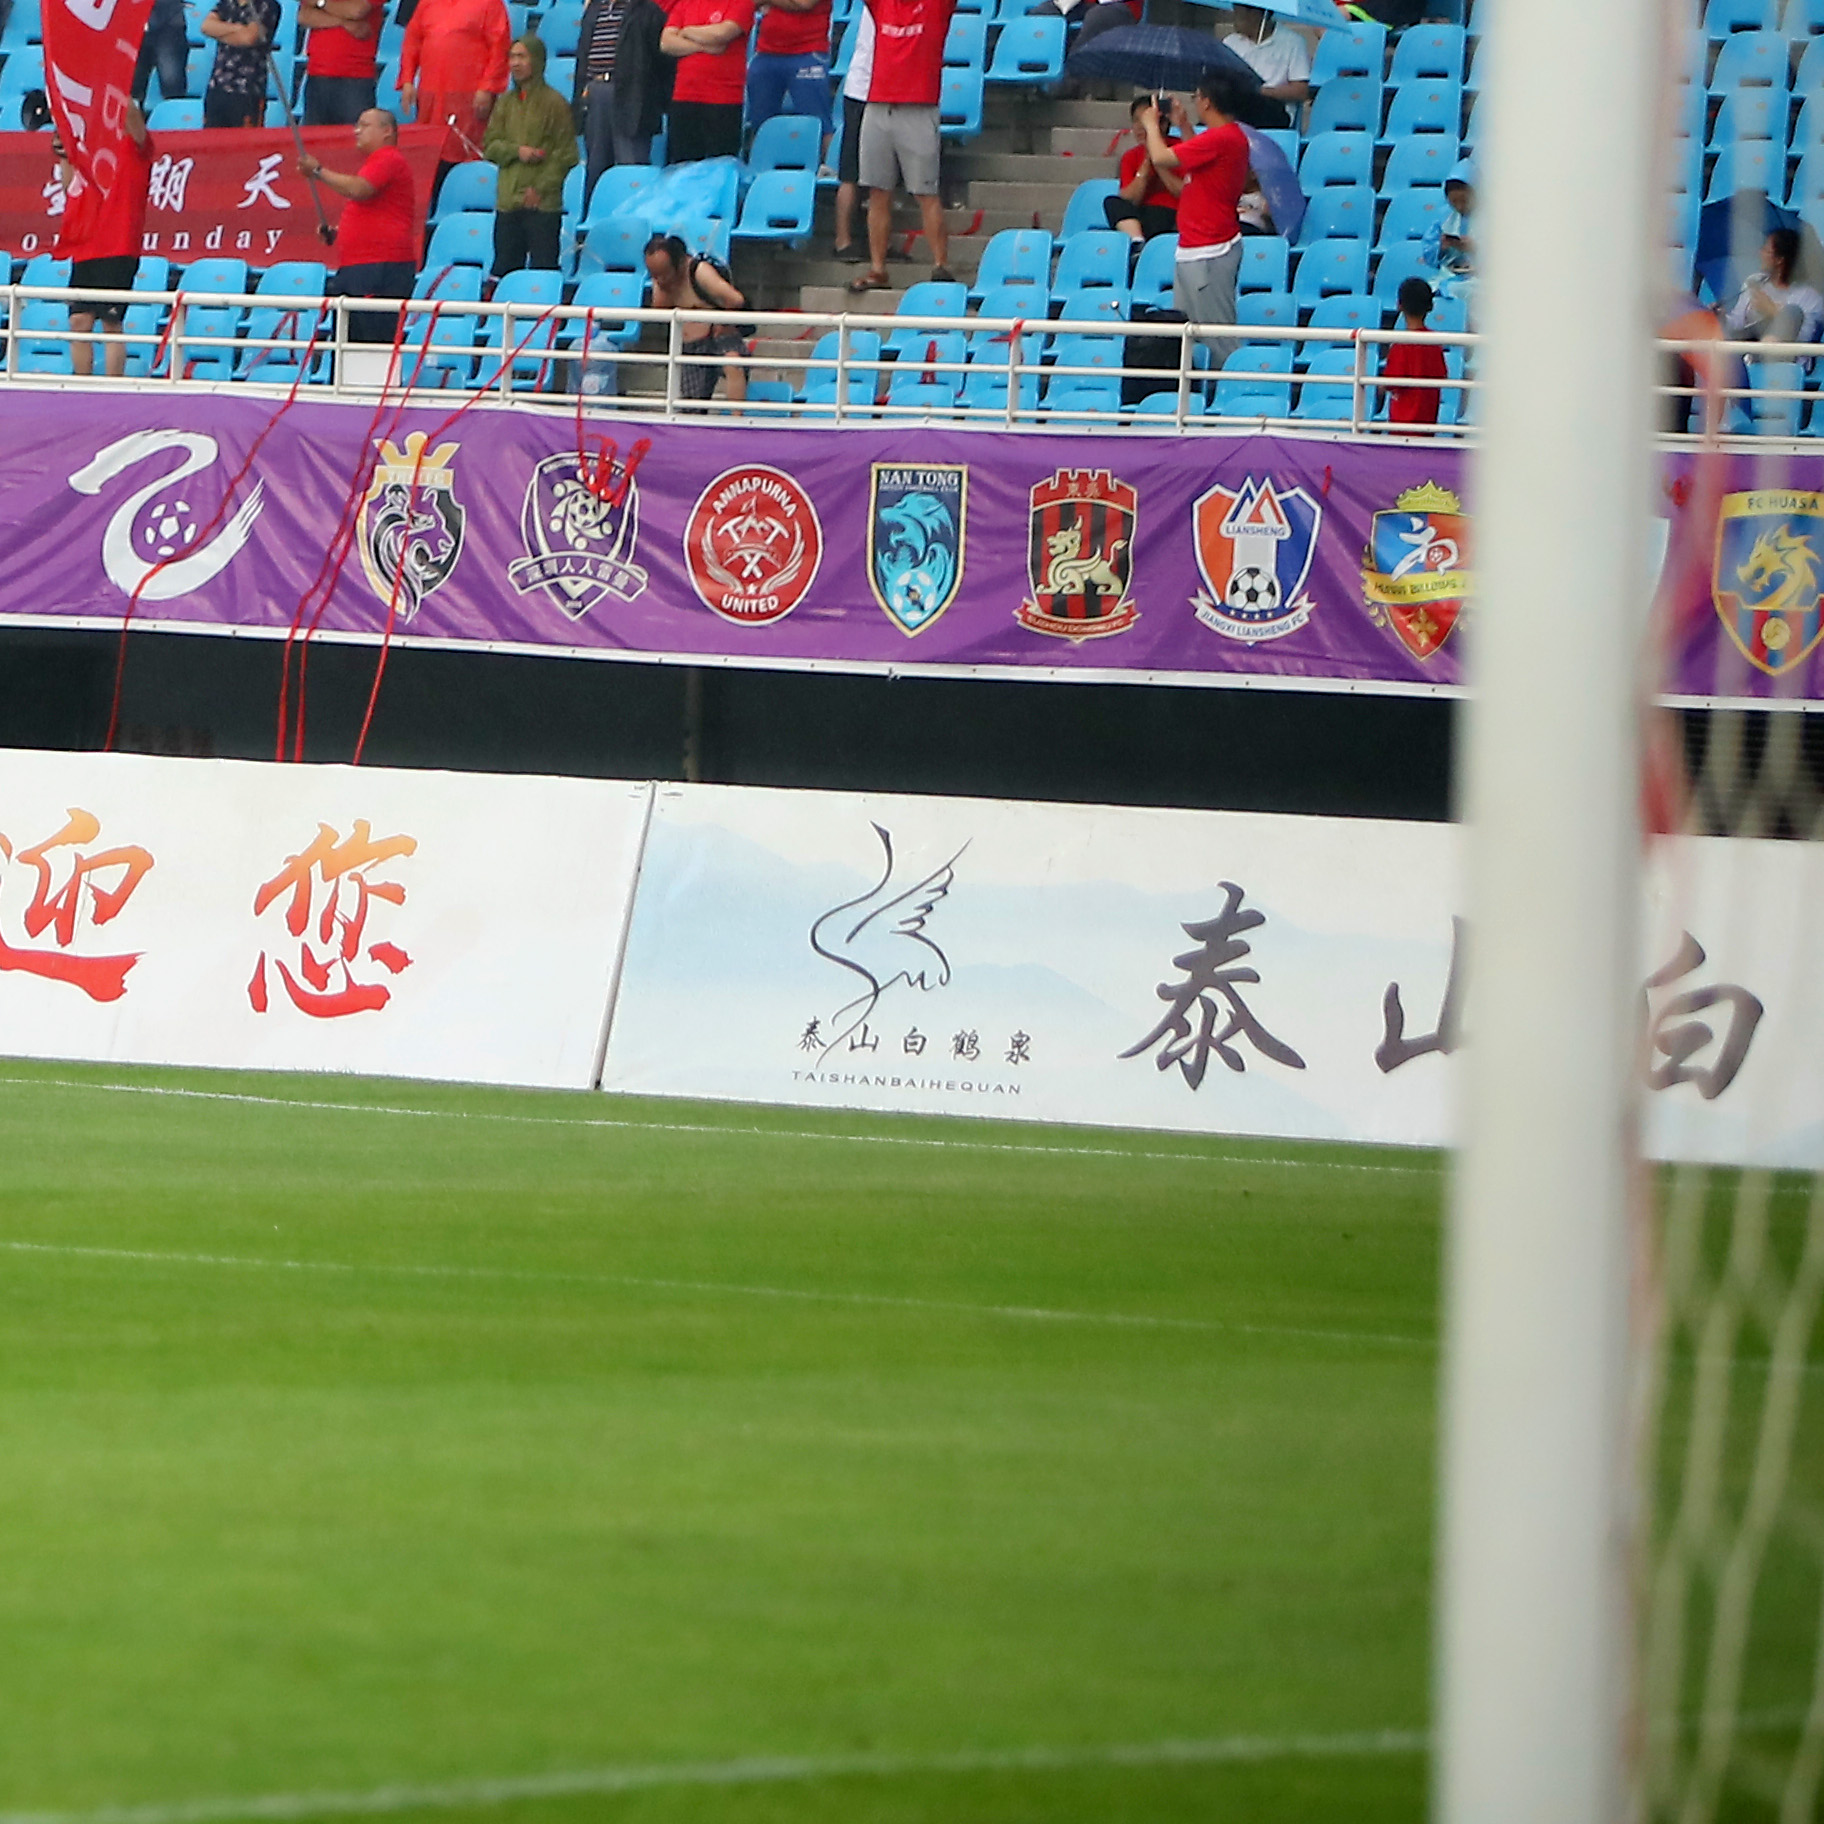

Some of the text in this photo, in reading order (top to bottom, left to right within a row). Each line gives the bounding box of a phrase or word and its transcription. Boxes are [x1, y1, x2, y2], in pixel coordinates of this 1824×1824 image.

[879, 470, 959, 486] NAN TONG
[712, 476, 798, 519] ANNAPURNA
[1226, 524, 1286, 537] LIANSHENG
[721, 593, 780, 614] UNITED
[798, 1016, 1032, 1065] 泰山白鹤泉
[791, 1070, 1021, 1095] TAISHANBAIHEQUAN
